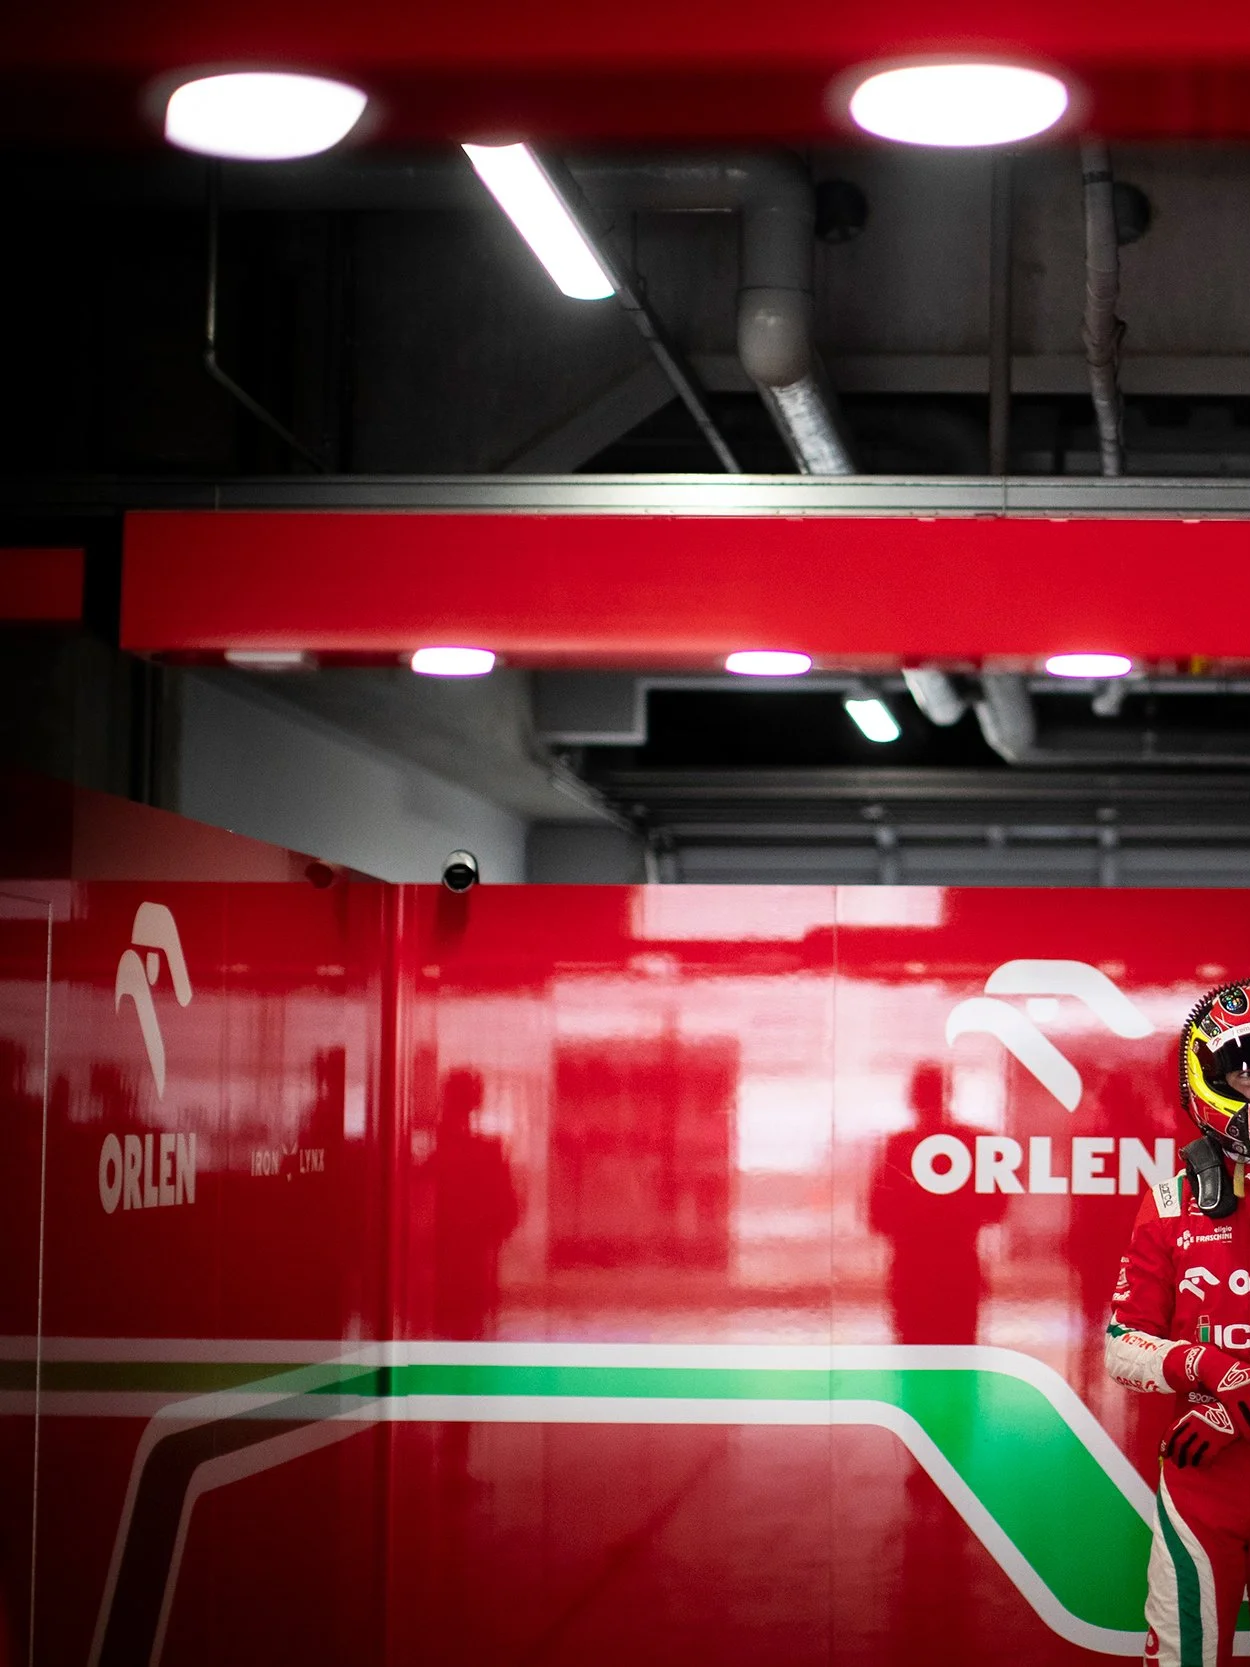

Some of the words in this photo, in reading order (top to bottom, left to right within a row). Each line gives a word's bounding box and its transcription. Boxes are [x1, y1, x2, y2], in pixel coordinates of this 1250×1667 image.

[98, 1132, 197, 1215] ORLEN
[250, 1149, 280, 1177] IRON
[299, 1148, 325, 1174] LYNX
[911, 1133, 1175, 1196] ORLEN
[1195, 1232, 1233, 1243] FRASCHINI
[1188, 1392, 1218, 1404] spar
